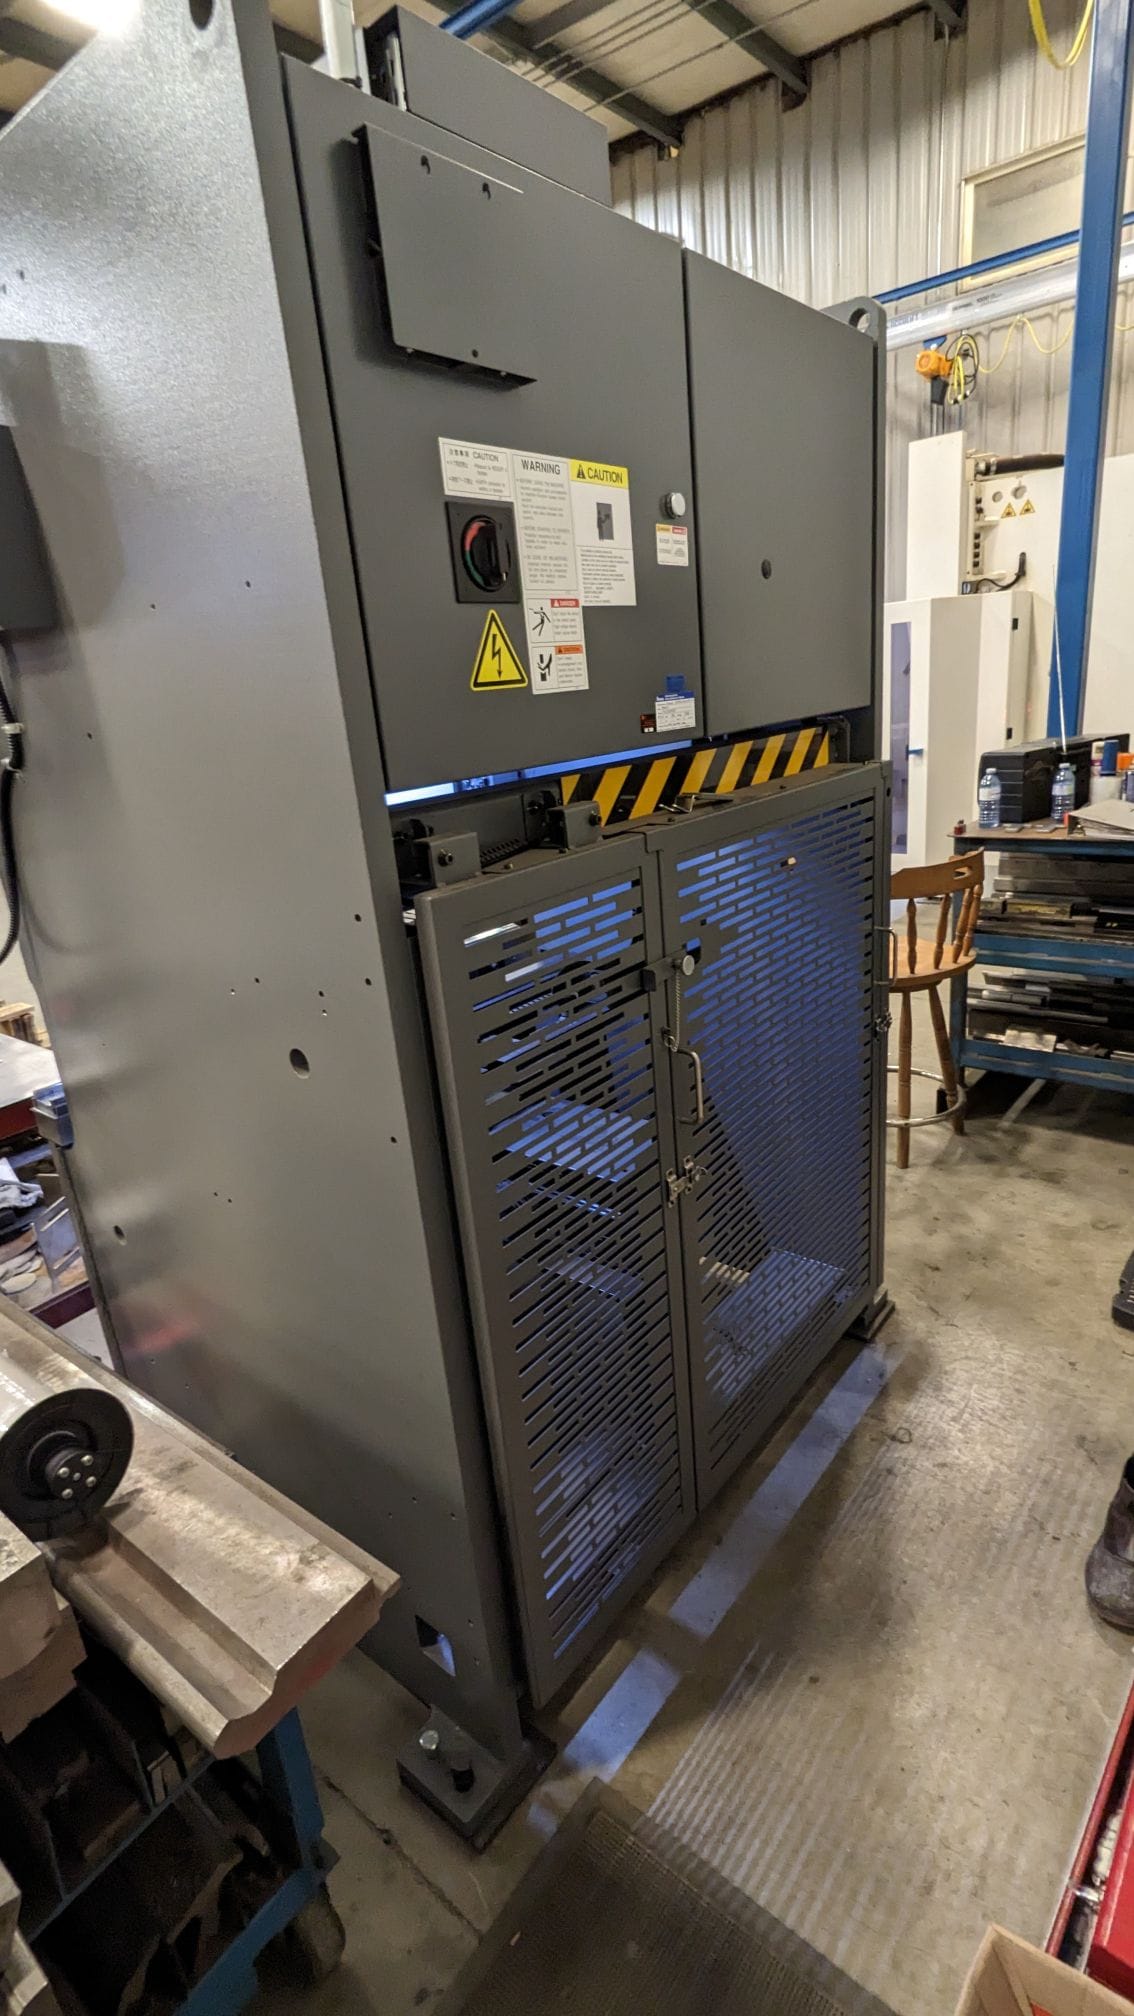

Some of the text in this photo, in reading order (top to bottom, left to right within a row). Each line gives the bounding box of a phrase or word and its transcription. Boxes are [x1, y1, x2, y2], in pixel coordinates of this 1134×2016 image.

[472, 451, 499, 462] CAUTION
[521, 458, 561, 475] WARNING
[587, 467, 623, 485] CAUTION
